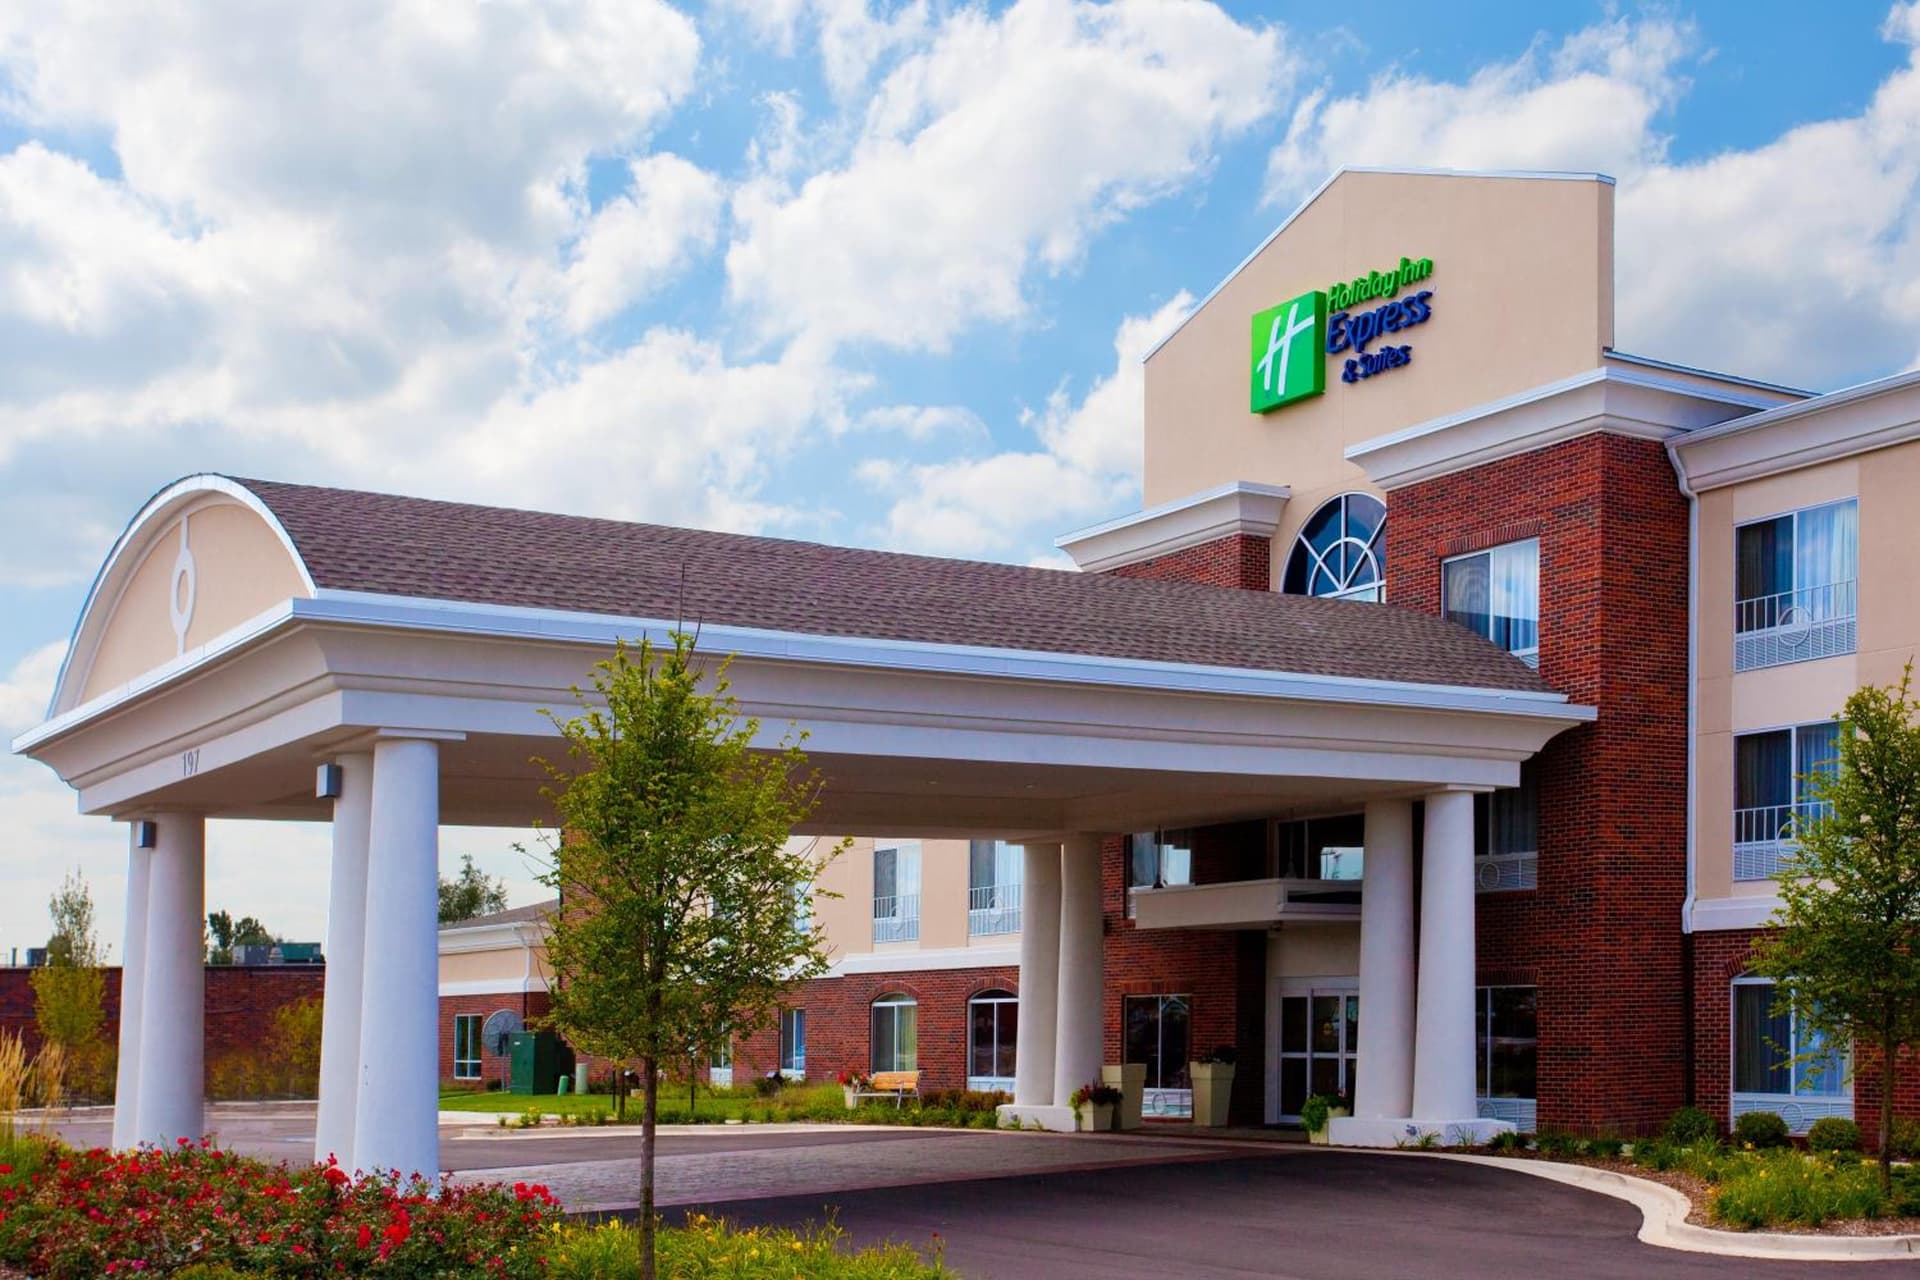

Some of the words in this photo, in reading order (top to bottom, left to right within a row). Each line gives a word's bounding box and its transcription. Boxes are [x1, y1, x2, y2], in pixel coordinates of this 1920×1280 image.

[1326, 270, 1400, 313] Holiday
[1399, 257, 1433, 287] Inn
[1325, 290, 1434, 355] Express
[1341, 358, 1359, 384] &
[1357, 345, 1413, 379] Suites
